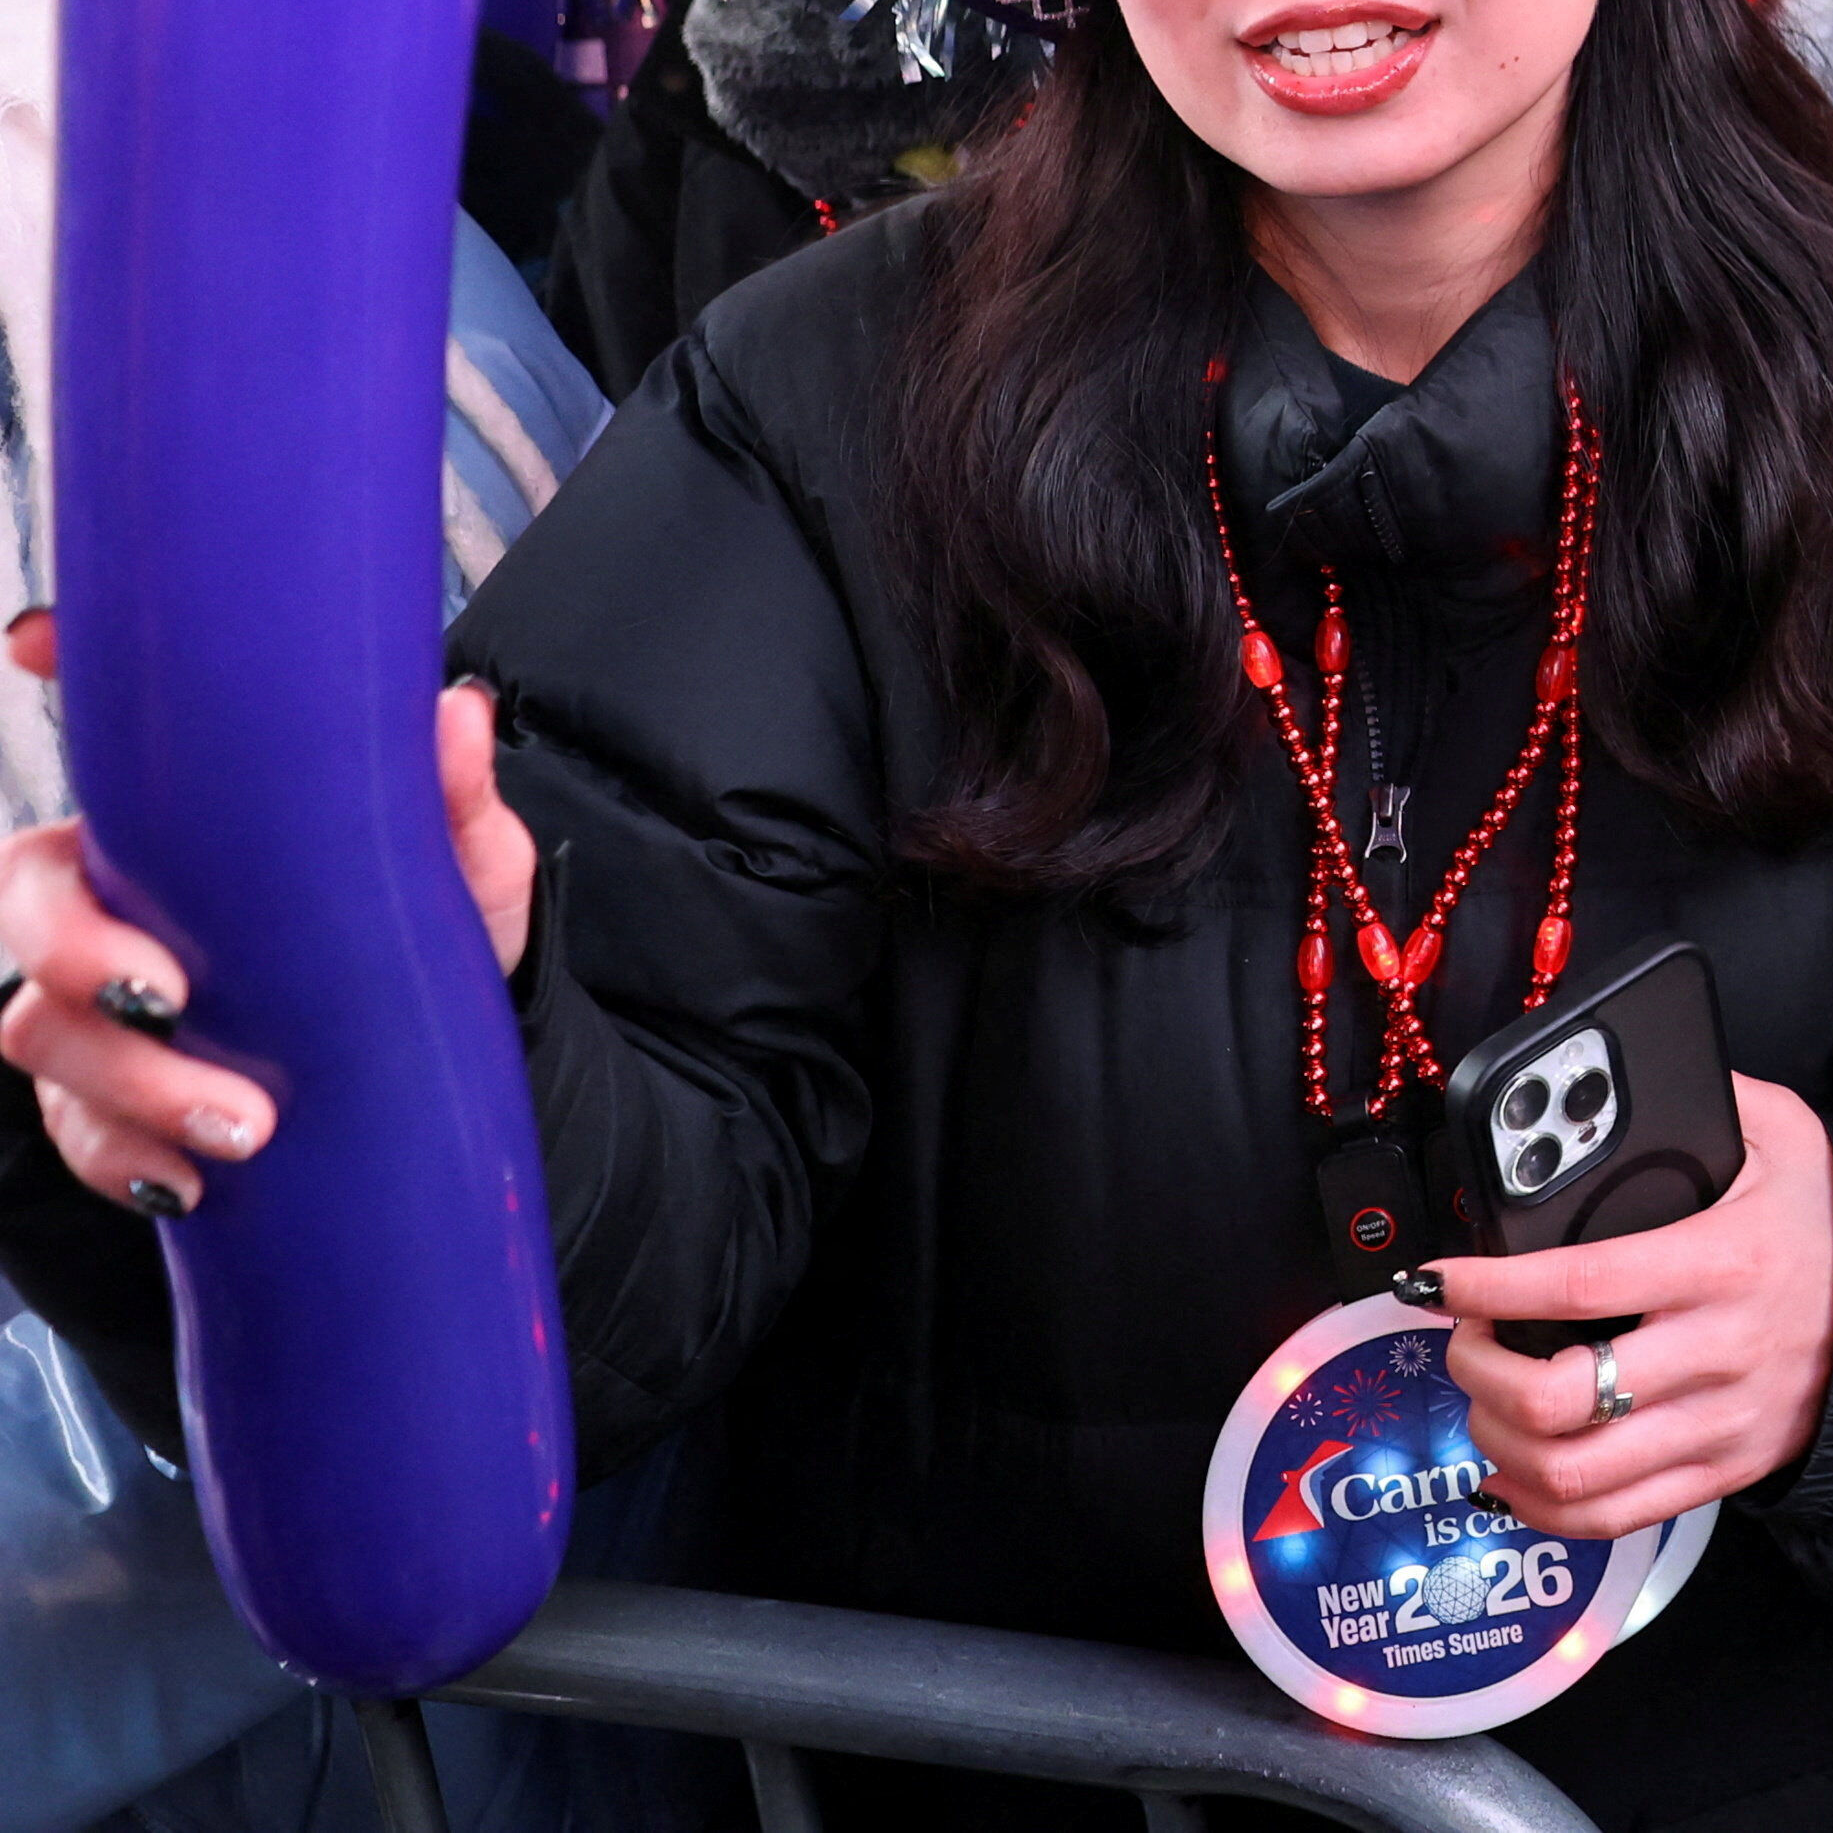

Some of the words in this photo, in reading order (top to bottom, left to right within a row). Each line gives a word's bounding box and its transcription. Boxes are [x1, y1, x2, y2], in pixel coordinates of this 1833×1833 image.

[1330, 1459, 1499, 1522] Carn
[1424, 1512, 1461, 1547] is
[1465, 1511, 1528, 1539] ca
[1317, 1578, 1385, 1617] New
[1321, 1610, 1391, 1649] Year
[1383, 1638, 1446, 1669] Times
[1449, 1623, 1524, 1656] Square
